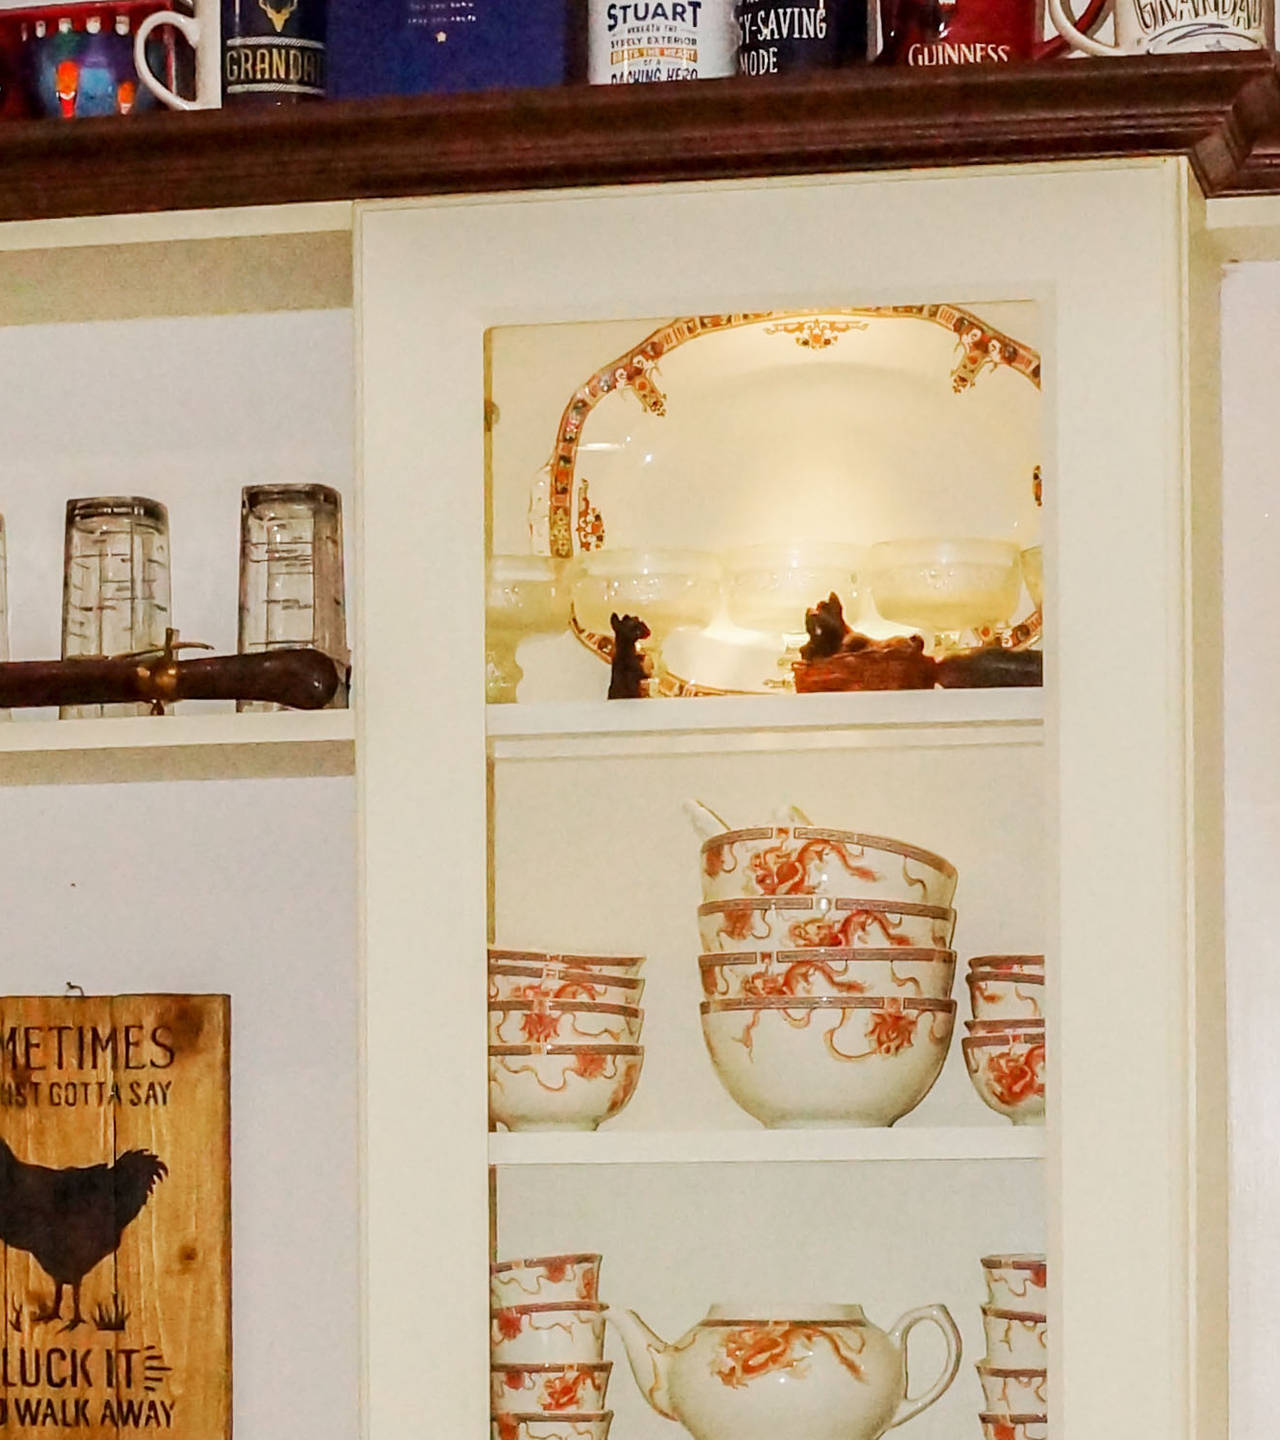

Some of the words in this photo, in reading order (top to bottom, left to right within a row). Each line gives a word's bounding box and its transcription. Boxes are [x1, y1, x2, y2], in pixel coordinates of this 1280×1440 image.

[607, 0, 702, 32] STUART
[646, 36, 698, 47] EXTERIOR
[907, 43, 1011, 67] GUINNESS
[226, 47, 324, 81] GRANDA
[49, 1081, 123, 1107] GOTTA
[129, 1080, 173, 1107] SAY
[105, 1348, 141, 1389] IT
[14, 1398, 91, 1427] WALK
[100, 1399, 176, 1429] AWAY
